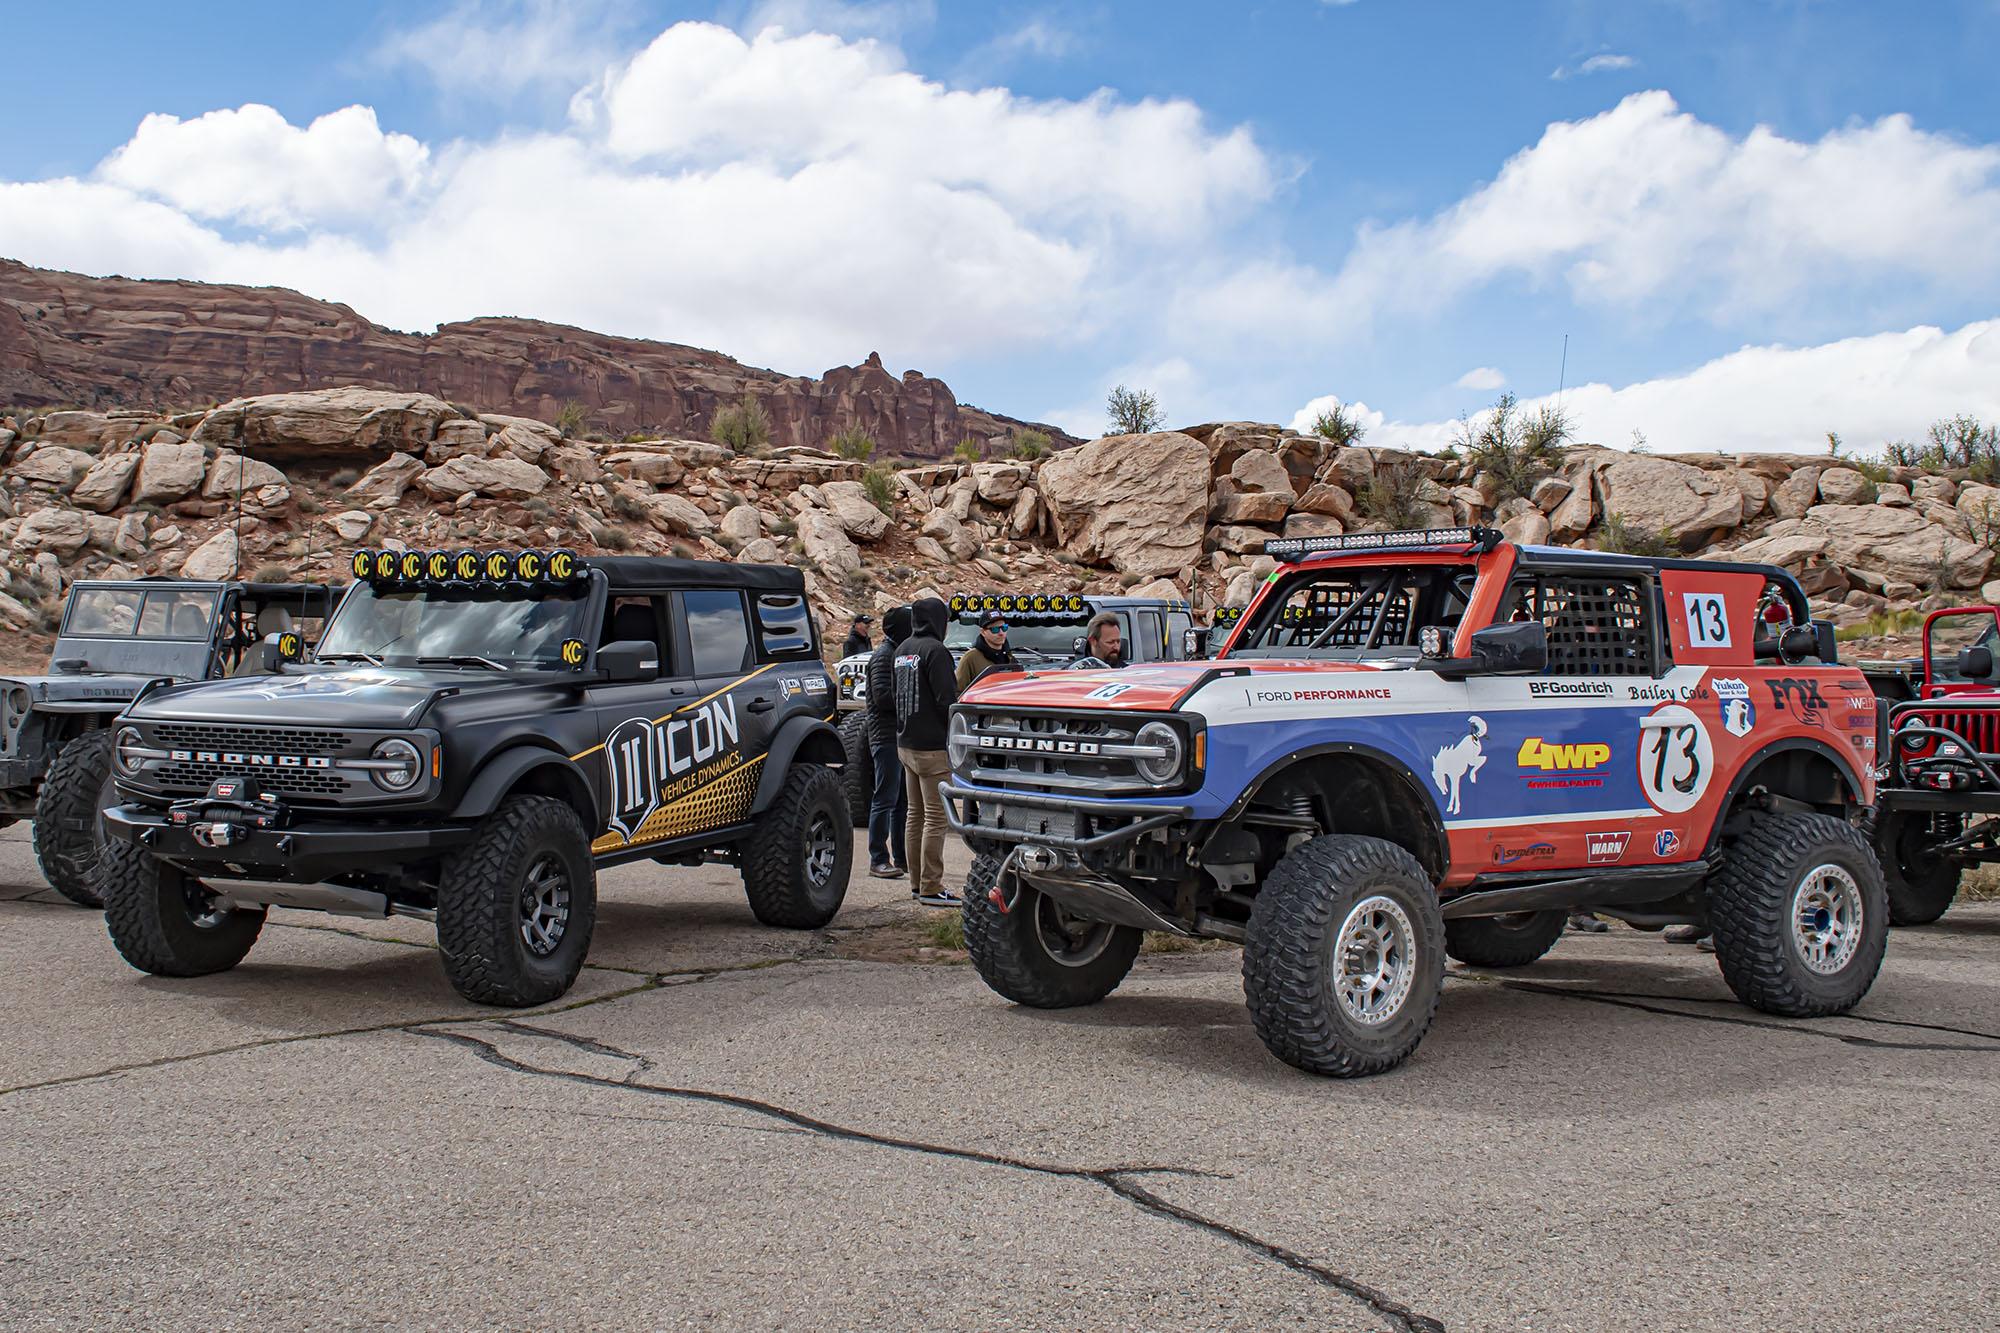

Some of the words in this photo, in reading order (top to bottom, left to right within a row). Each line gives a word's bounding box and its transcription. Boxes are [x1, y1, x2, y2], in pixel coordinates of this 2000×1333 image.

[354, 553, 369, 576] KC
[377, 553, 394, 577] KC
[402, 554, 420, 578] KC
[429, 554, 447, 578] KC
[457, 554, 476, 579] KC
[487, 554, 507, 579] KC
[519, 554, 539, 579] KC
[550, 554, 572, 578] KC
[951, 596, 962, 610] KC
[967, 596, 978, 610] KC
[983, 596, 995, 609] KC
[1000, 596, 1011, 610] KC
[1016, 596, 1028, 610] KC
[1033, 596, 1045, 610] KC
[1051, 596, 1063, 610] KC
[1068, 596, 1081, 610] KC
[1690, 598, 1726, 642] 13
[280, 635, 296, 656] KC
[562, 641, 582, 664] KC
[1093, 683, 1131, 697] 13
[1257, 691, 1293, 702] FORD
[1294, 688, 1392, 701] PERFORMANCE
[1529, 681, 1614, 694] BFGoodrich
[1628, 685, 1676, 704] Bailey
[1680, 686, 1710, 700] Cole
[1714, 681, 1746, 690] Yukon
[1764, 678, 1829, 710] FOX
[657, 693, 739, 781] ICON
[980, 736, 1099, 755] BRONCO
[171, 750, 330, 768] BRONCO
[1518, 738, 1611, 771] 4WP
[1651, 722, 1701, 794] 13
[661, 770, 697, 801] VEHICLE
[1591, 841, 1623, 855] WARN
